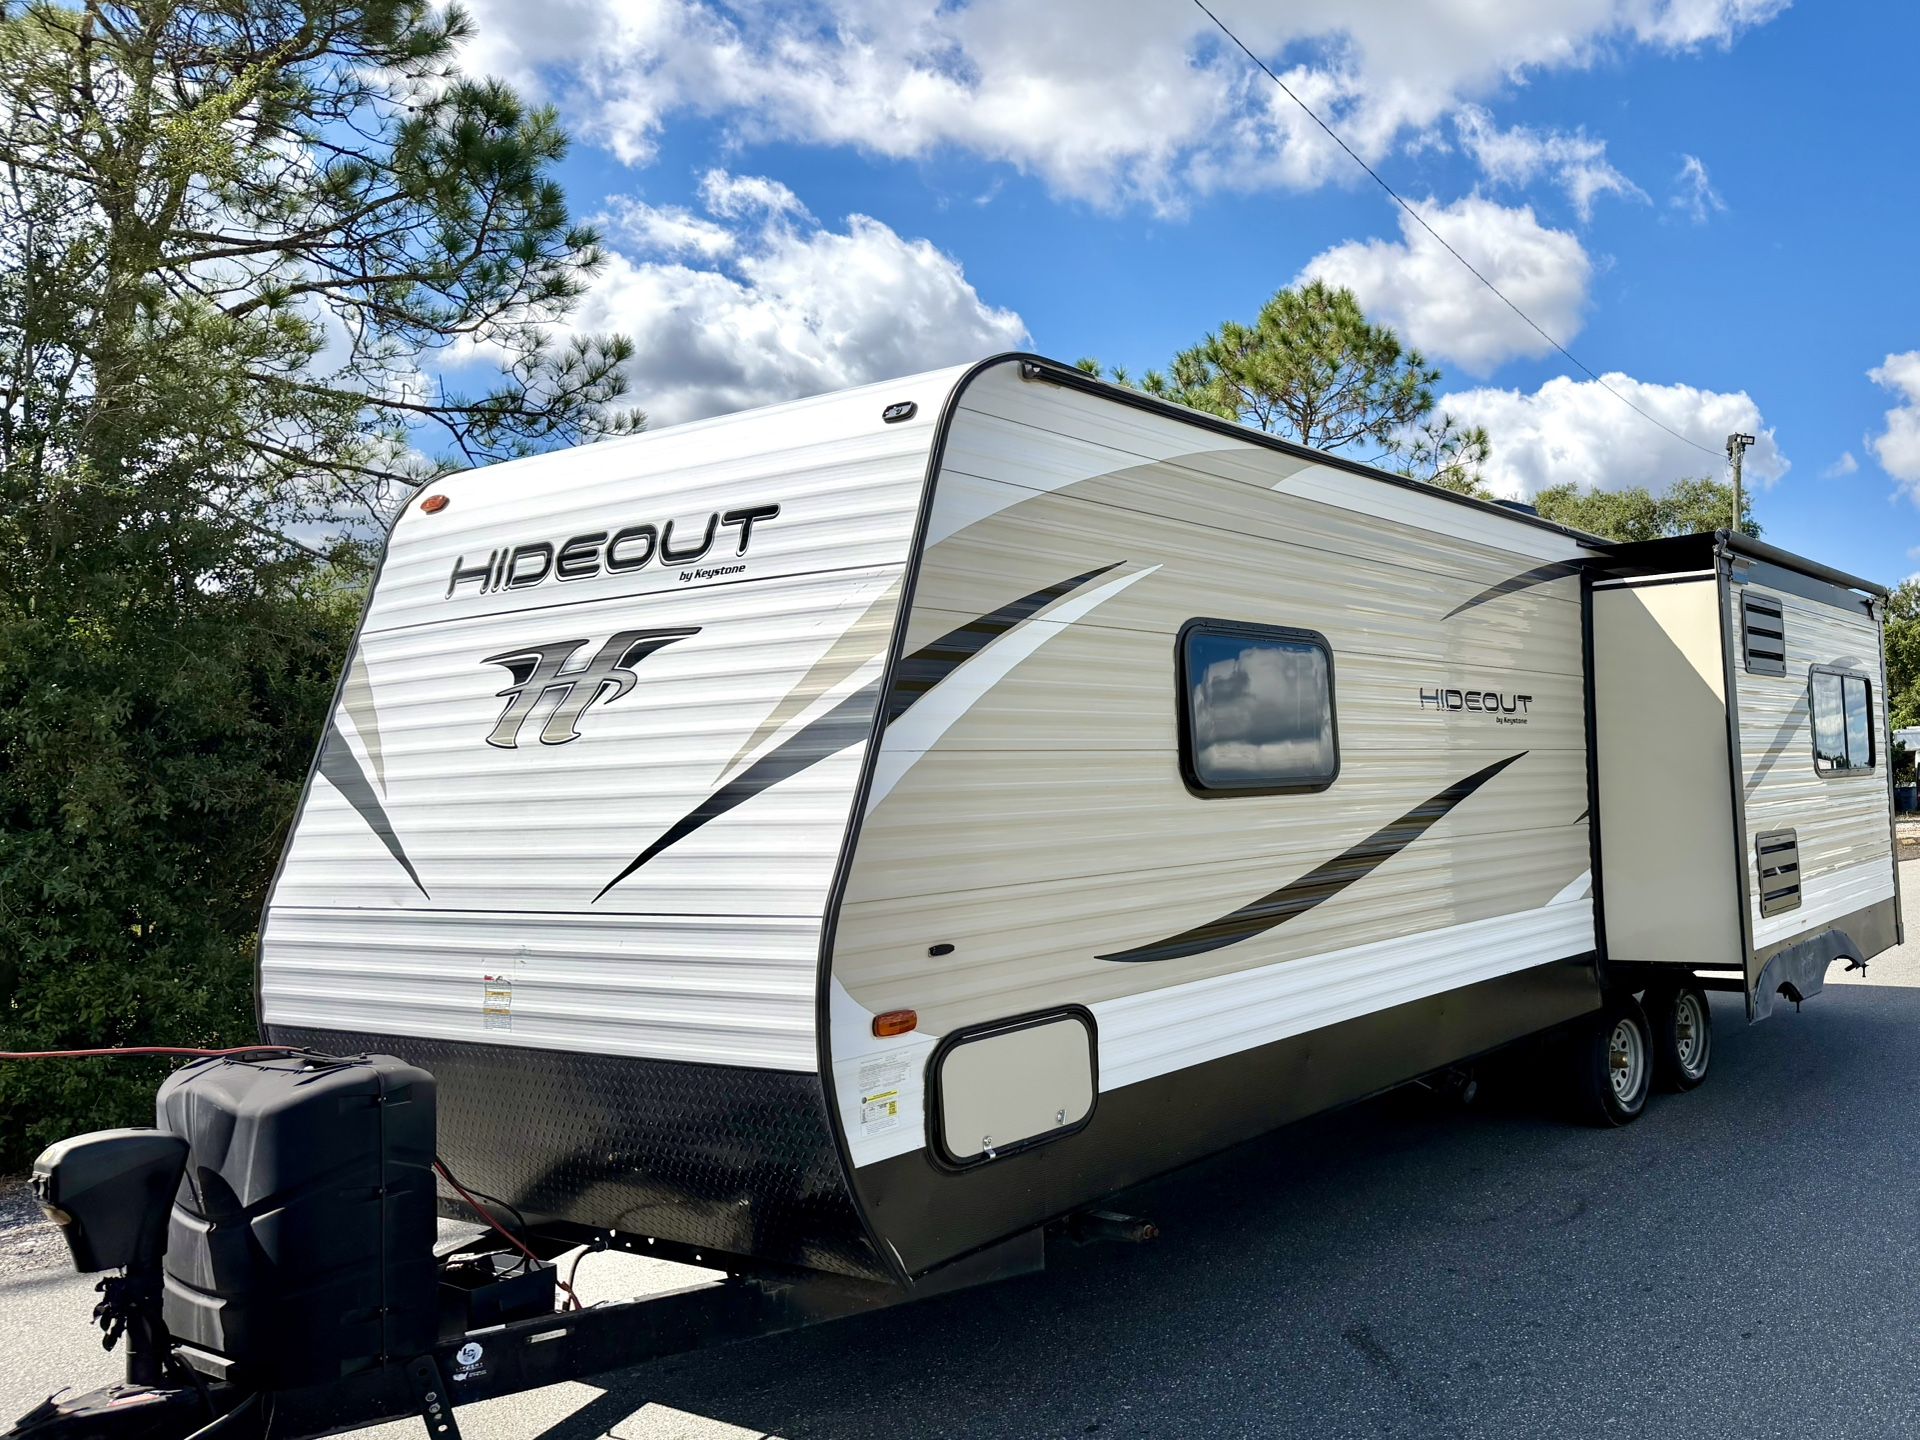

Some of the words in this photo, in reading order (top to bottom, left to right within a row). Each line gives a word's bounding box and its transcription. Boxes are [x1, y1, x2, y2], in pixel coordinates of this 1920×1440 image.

[445, 502, 780, 600] HIDEOUT
[679, 571, 693, 583] by
[694, 565, 745, 579] Keystone
[1419, 687, 1533, 714] HIDEOUT
